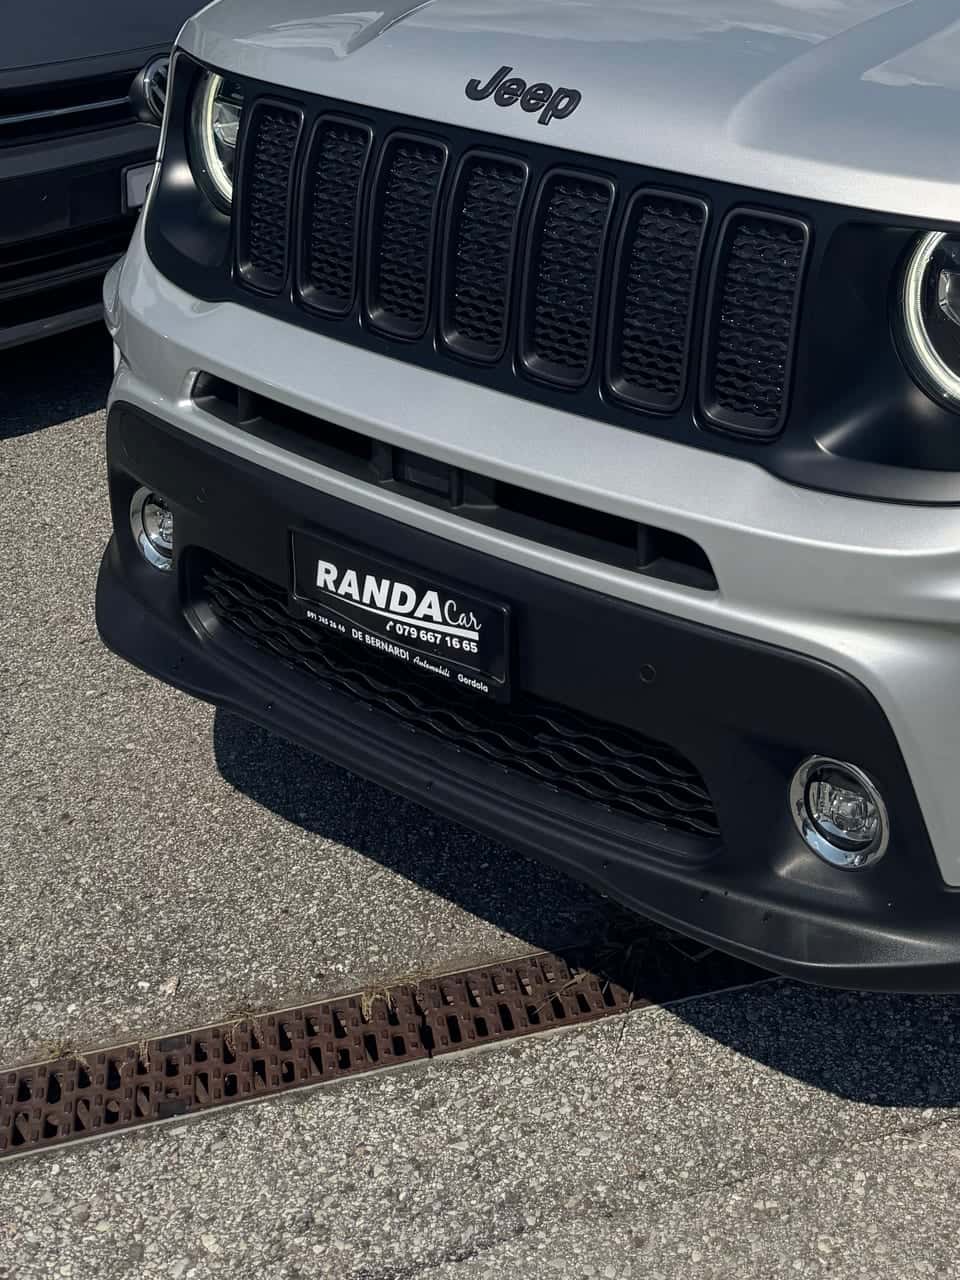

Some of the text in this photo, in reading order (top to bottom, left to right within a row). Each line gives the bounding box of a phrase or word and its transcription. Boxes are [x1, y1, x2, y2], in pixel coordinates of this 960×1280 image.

[465, 65, 582, 126] Jeep
[316, 559, 482, 630] RANDA Car
[351, 628, 363, 641] DE
[365, 634, 410, 661] BERNARDI
[413, 656, 451, 677] Automobili
[457, 673, 489, 693] Gordola
[395, 623, 479, 653] 079 667 16 65
